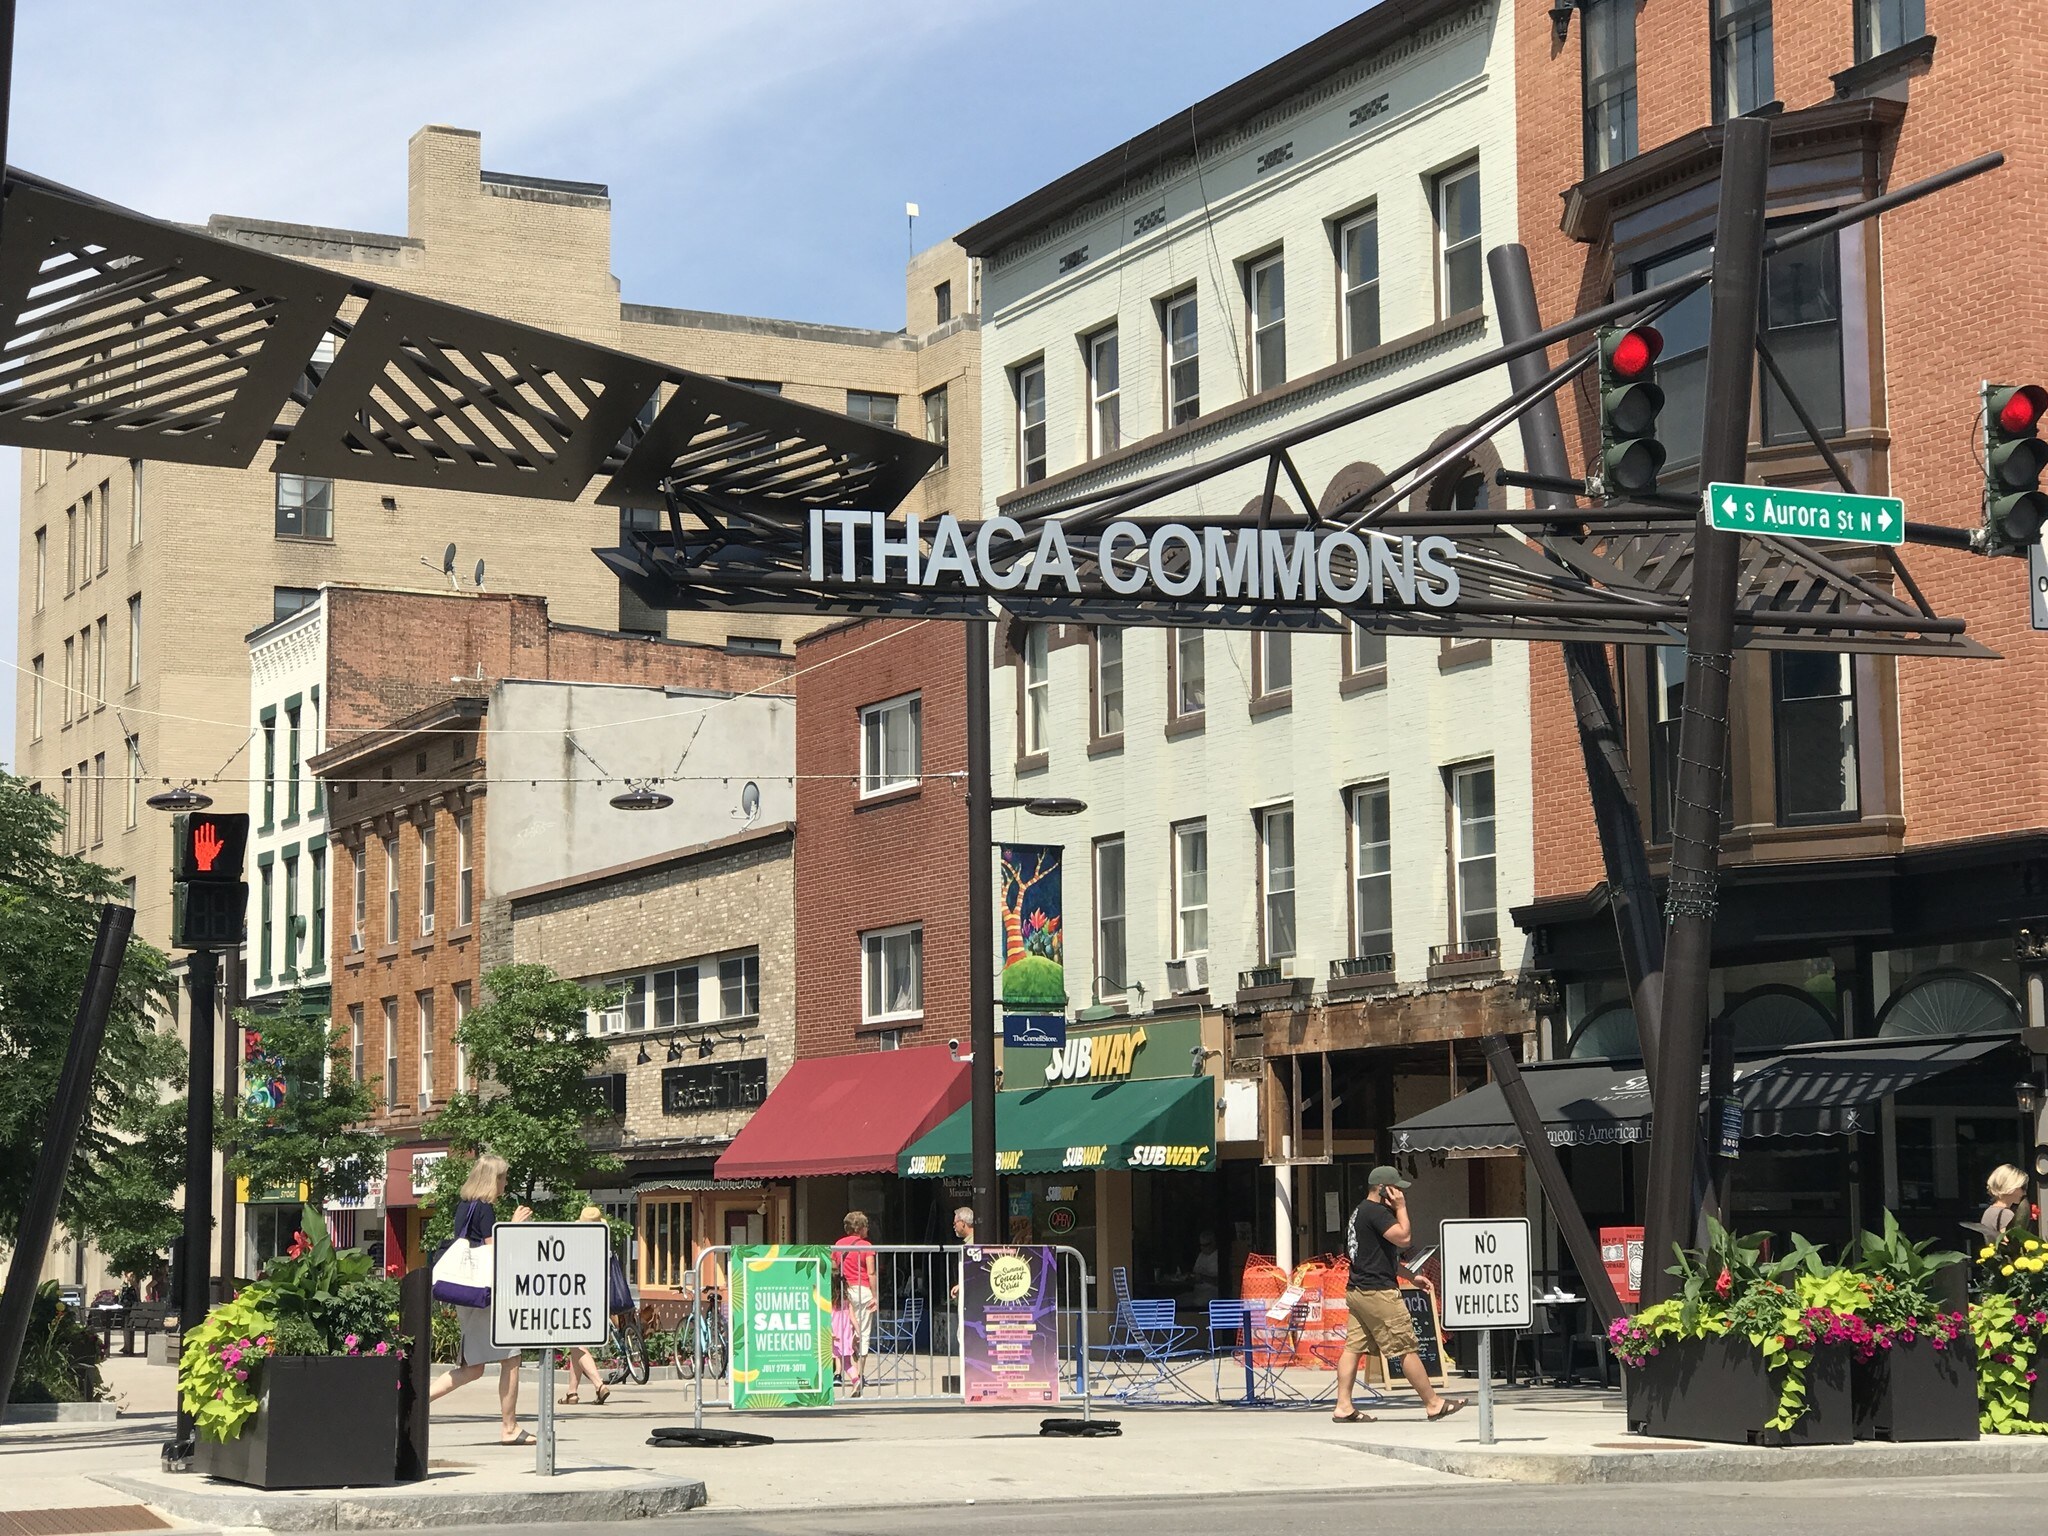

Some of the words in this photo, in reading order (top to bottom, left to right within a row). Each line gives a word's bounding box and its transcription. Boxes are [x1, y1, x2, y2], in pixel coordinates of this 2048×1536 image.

[1745, 502, 1755, 522] S
[1763, 497, 1830, 529] Aurora
[1837, 510, 1854, 530] St
[1861, 512, 1871, 531] N
[809, 509, 1081, 593] ITHACA
[1098, 521, 1461, 607] COMMONS
[1045, 1027, 1147, 1081] SUBWAY
[1588, 1122, 1643, 1140] American
[908, 1154, 946, 1175] SUBWAY
[996, 1150, 1024, 1171] BWAY
[1062, 1144, 1108, 1167] SUBWAY
[1127, 1145, 1210, 1166] SUBWAY
[280, 1190, 297, 1198] STORE
[1046, 1185, 1078, 1201] SUBWAY
[1052, 1212, 1072, 1228] OPEN
[538, 1239, 565, 1262] NO
[1475, 1234, 1497, 1254] NO
[994, 1271, 1027, 1287] Concert
[1002, 1265, 1025, 1276] Summer
[1459, 1264, 1514, 1284] MOTOR
[516, 1273, 586, 1296] MOTOR
[1000, 1281, 1020, 1294] Series
[755, 1291, 810, 1311] SUMMER
[1455, 1293, 1519, 1315] VEHICLES
[509, 1307, 592, 1331] VEHICLES
[754, 1312, 812, 1331] SALE
[755, 1332, 812, 1351] WEEKEND
[762, 1364, 776, 1373] JULY
